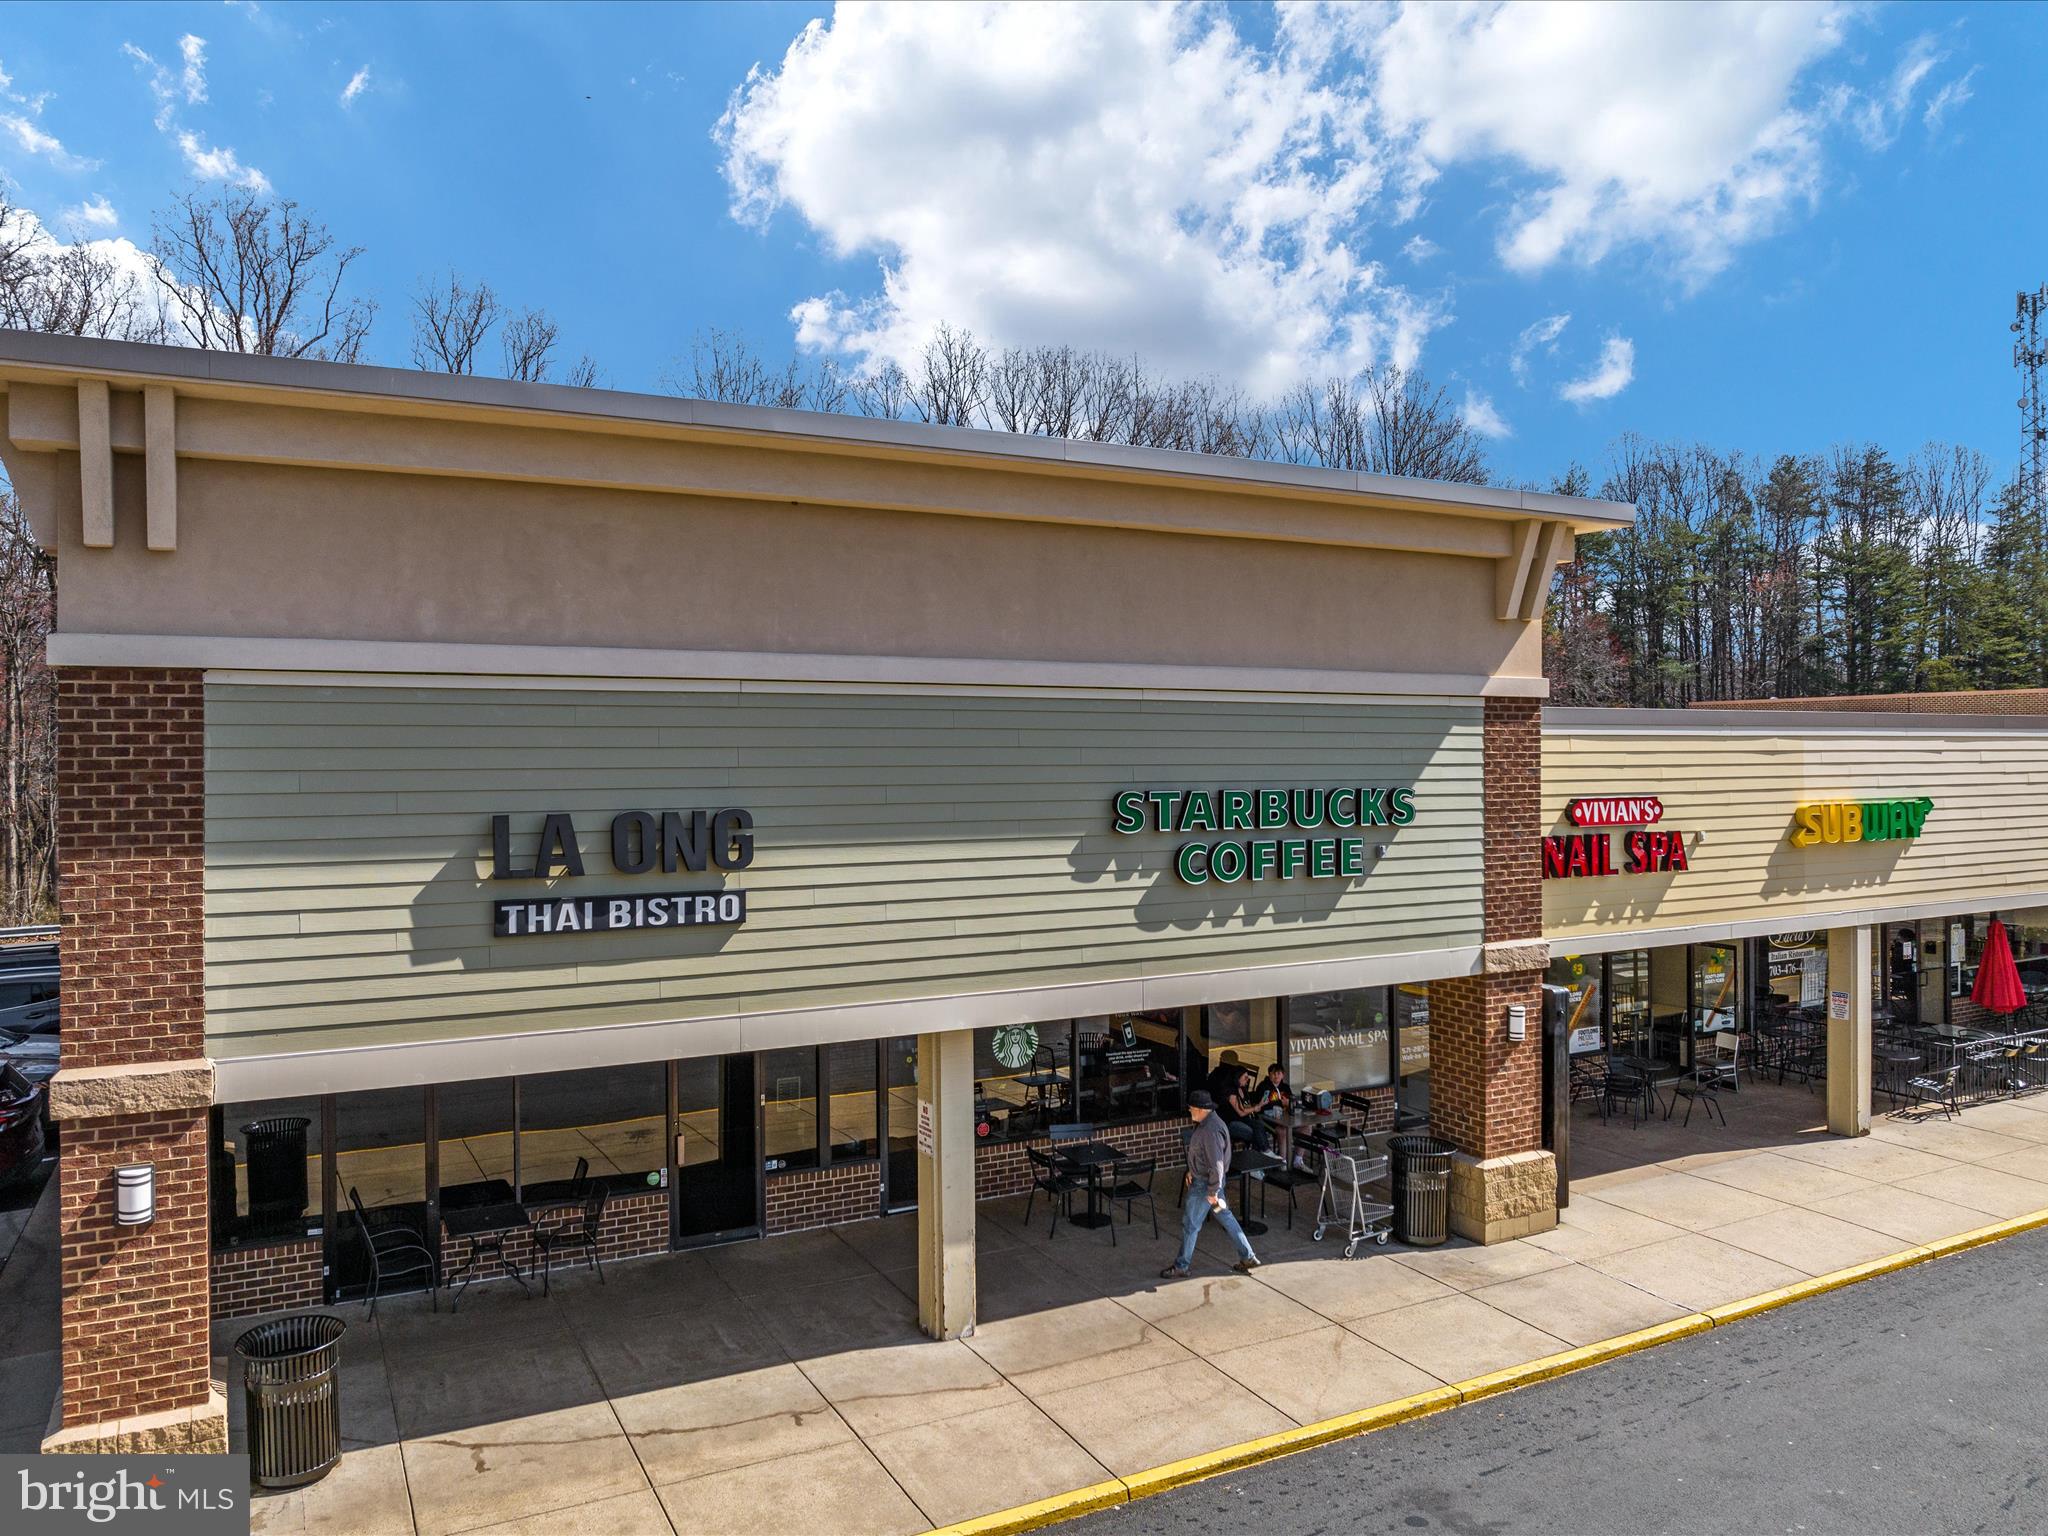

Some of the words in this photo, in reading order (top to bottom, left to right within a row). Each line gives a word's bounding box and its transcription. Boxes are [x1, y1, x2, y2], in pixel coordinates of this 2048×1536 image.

[1113, 787, 1416, 834] STARBUCKS
[1581, 799, 1655, 823] VIVIAN'S
[1790, 796, 1934, 848] SUBWAY
[492, 813, 585, 880] LA
[611, 808, 754, 874] ONG
[1175, 838, 1364, 885] COFFEE
[1541, 833, 1619, 880] NAIL
[1624, 830, 1689, 874] SPA
[501, 901, 593, 934] THAI
[609, 894, 740, 929] BISTRO
[1573, 963, 1583, 975] $3
[1771, 952, 1788, 960] Italian
[1290, 1035, 1335, 1053] VIVIAN'S
[1339, 1031, 1365, 1047] NAIL
[1368, 1029, 1388, 1043] SPA
